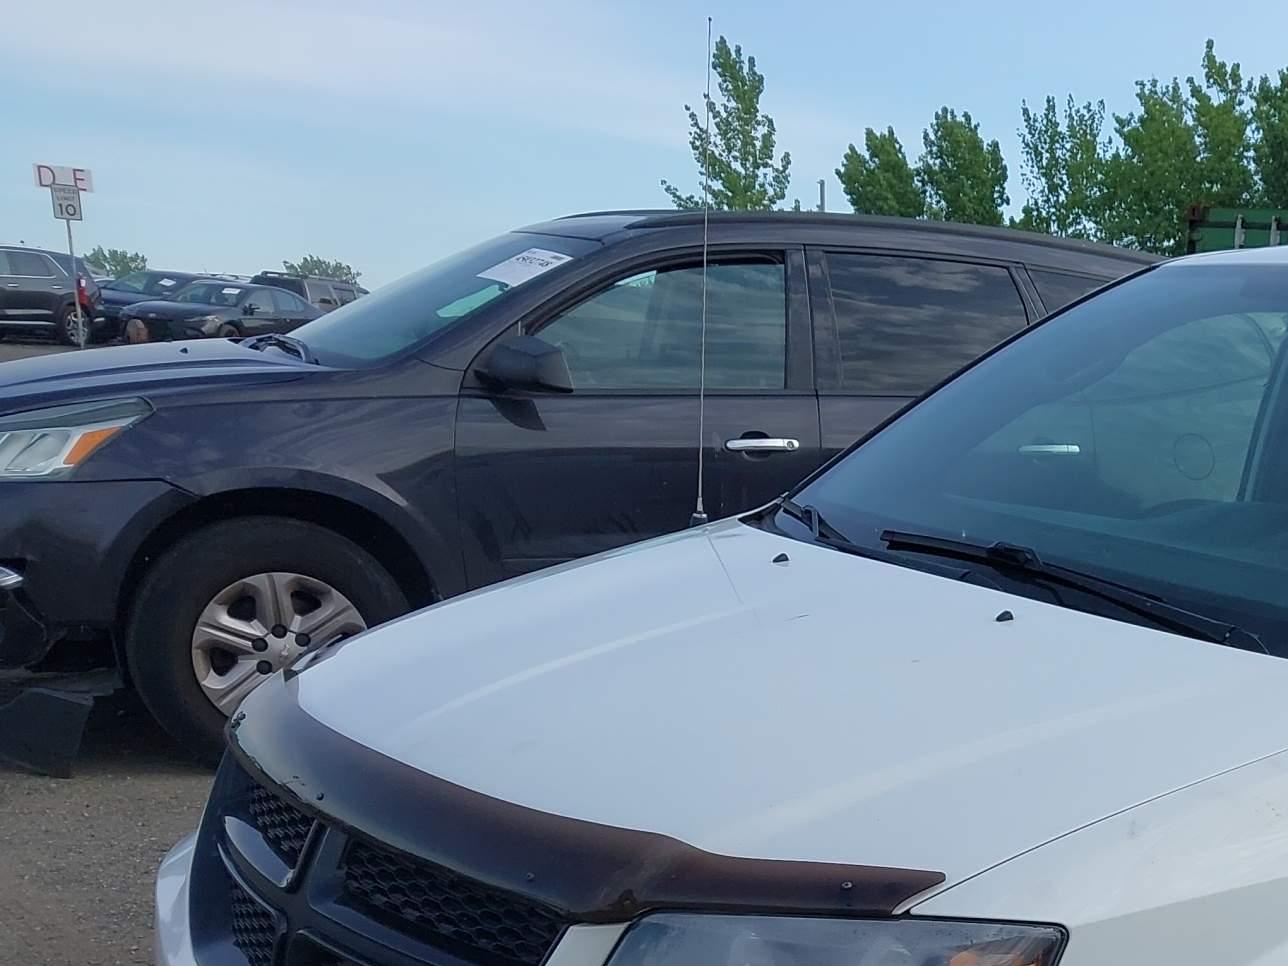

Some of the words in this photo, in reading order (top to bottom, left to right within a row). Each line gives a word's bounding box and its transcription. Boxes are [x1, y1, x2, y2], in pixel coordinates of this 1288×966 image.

[37, 165, 55, 187] D
[73, 168, 87, 191] E
[57, 203, 77, 217] 10
